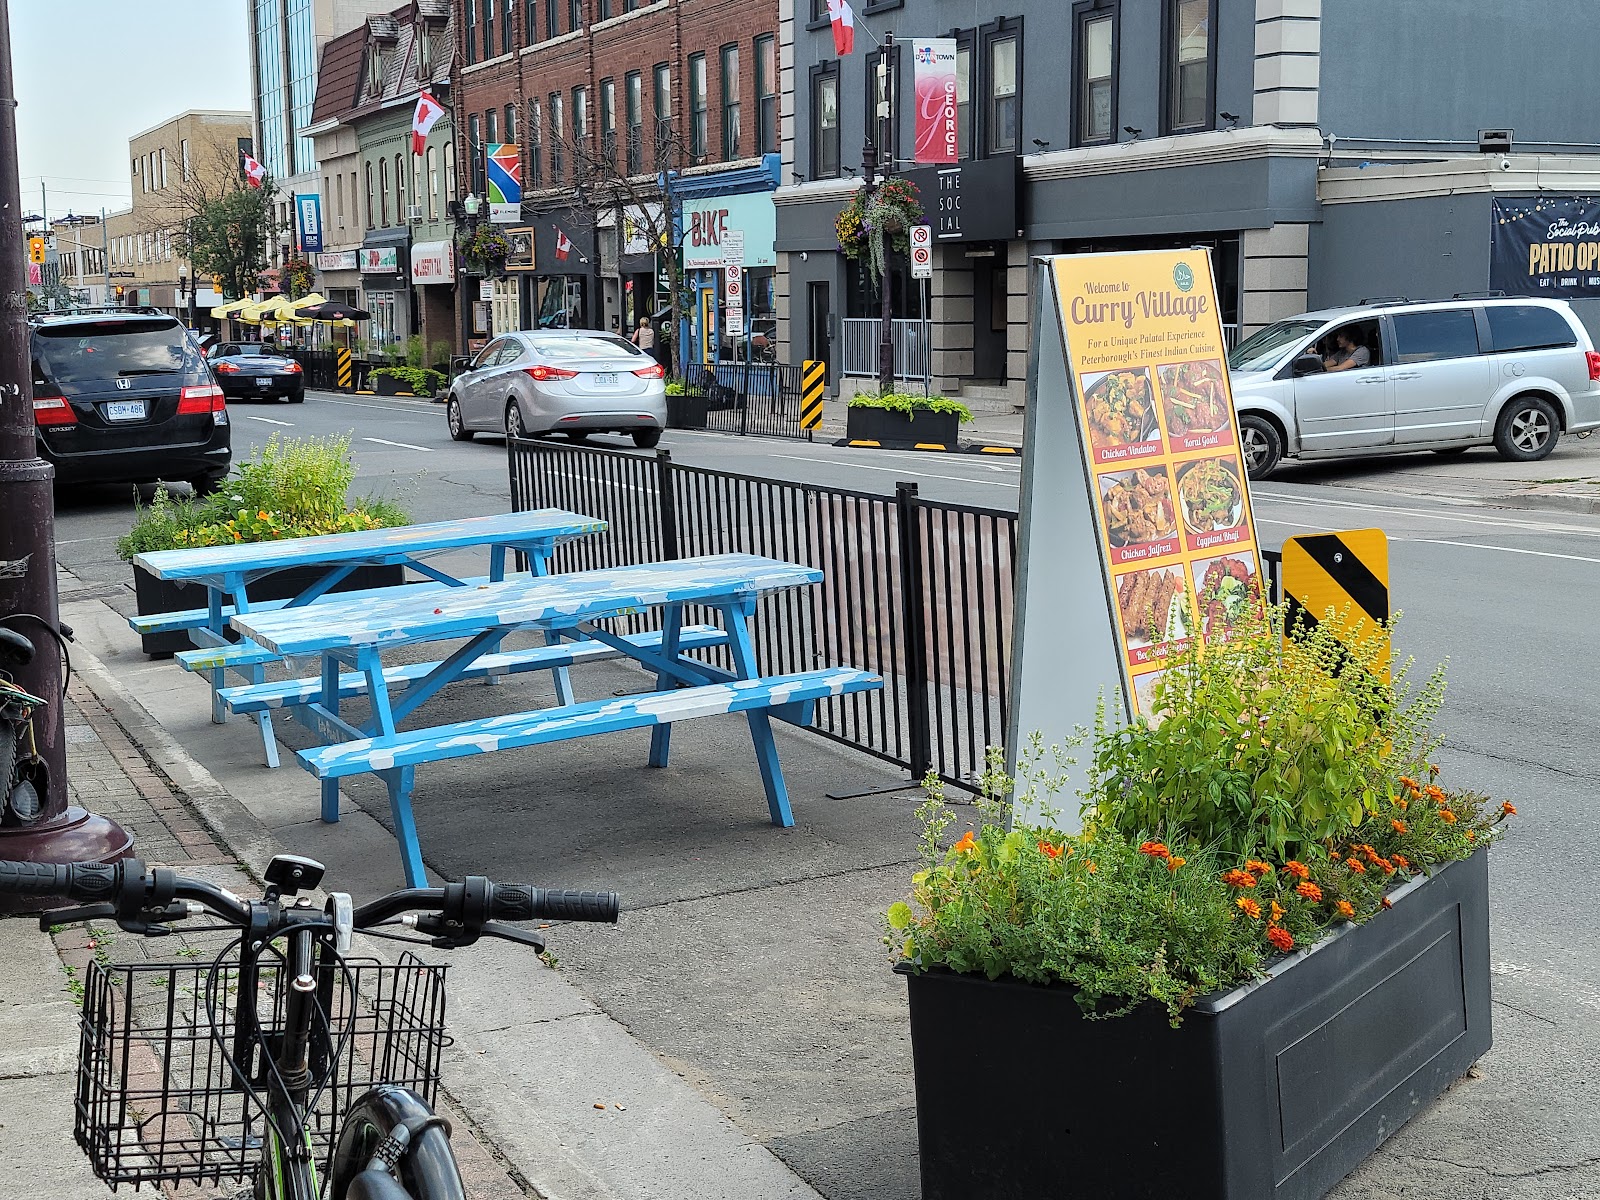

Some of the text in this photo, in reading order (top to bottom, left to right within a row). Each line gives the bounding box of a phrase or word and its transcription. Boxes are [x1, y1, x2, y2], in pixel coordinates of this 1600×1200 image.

[915, 53, 955, 61] DOWNTOWN
[944, 81, 956, 156] GEORGE
[939, 174, 960, 191] THE
[939, 195, 961, 211] SOC
[306, 202, 314, 232] REFRAME
[1557, 217, 1569, 227] The
[1546, 221, 1600, 240] Social Pub
[1529, 241, 1600, 276] PATIO OP
[1083, 280, 1130, 295] Welcome to
[1539, 278, 1550, 287] EAT
[1560, 277, 1578, 287] DRINK
[1071, 290, 1209, 329] Curry Village
[1087, 329, 1206, 349] For a Unique Palatal Experience
[1080, 342, 1216, 365] Peterborough's Finest Indian Cuisine
[48, 425, 77, 433] ODYSSEY
[1101, 444, 1157, 460] Chicken Vindaloo
[1196, 529, 1240, 548] Eggplant Bhaji
[1121, 542, 1172, 560] Chicken Jalfrezi
